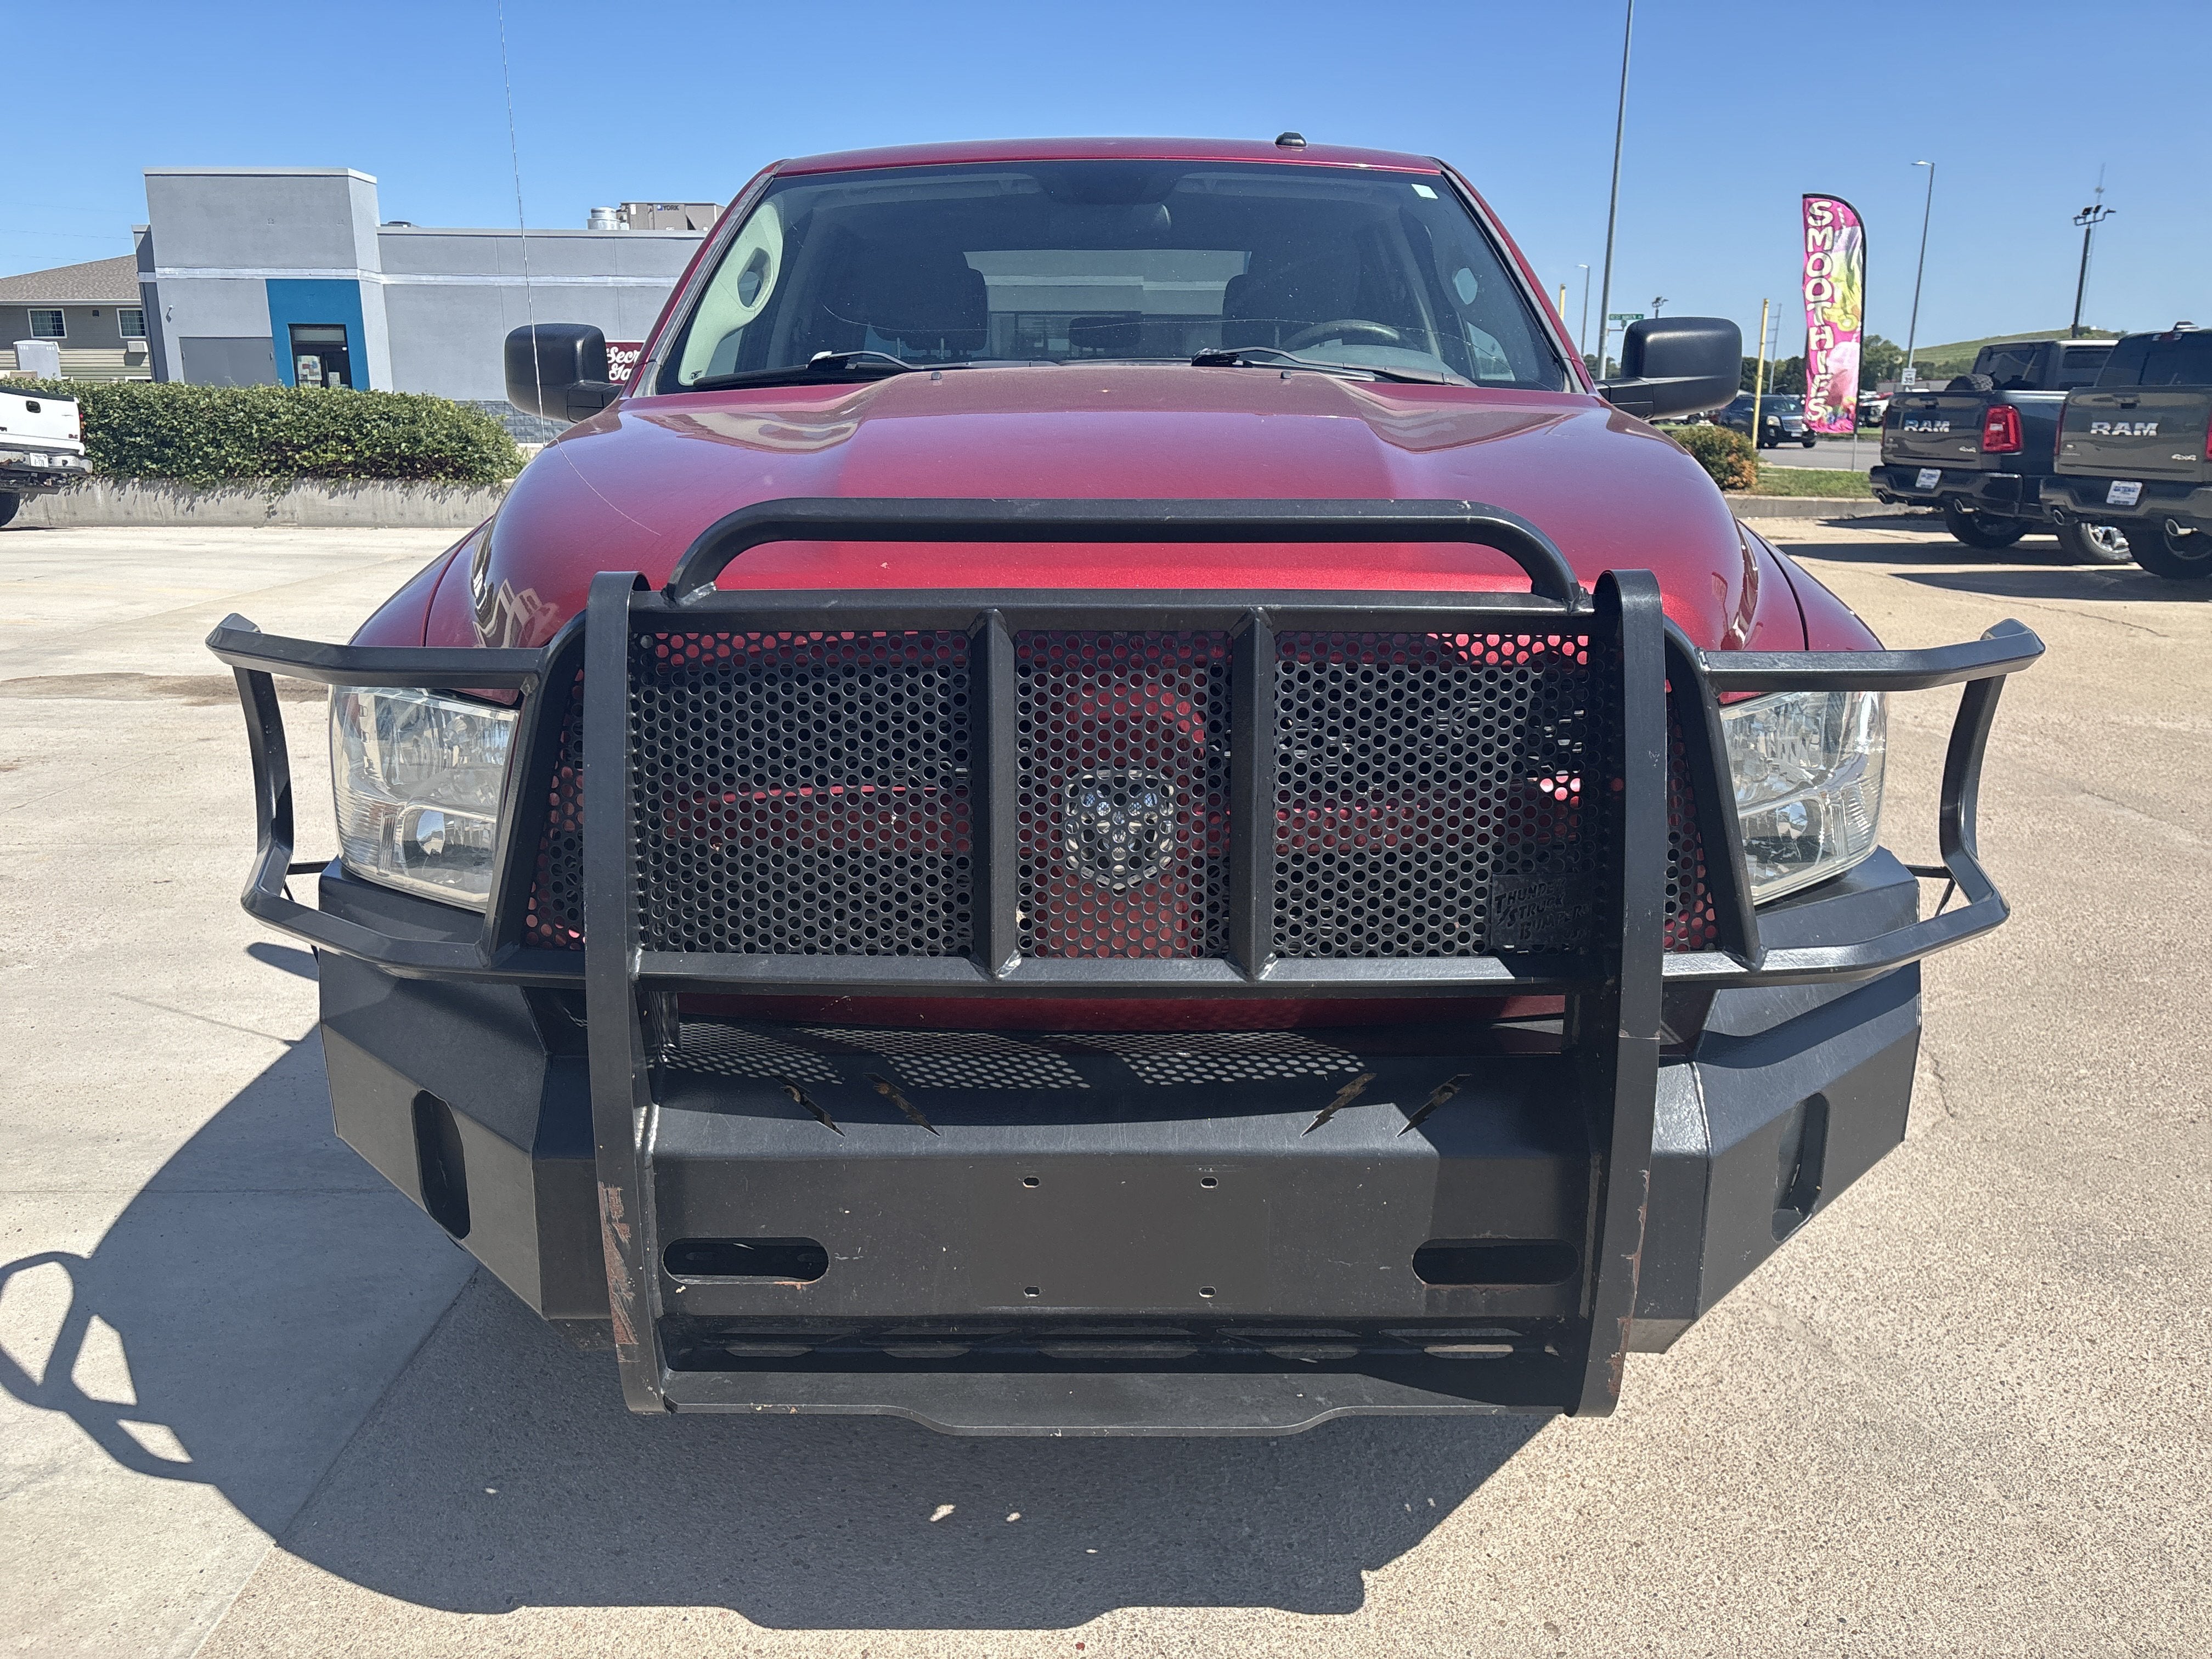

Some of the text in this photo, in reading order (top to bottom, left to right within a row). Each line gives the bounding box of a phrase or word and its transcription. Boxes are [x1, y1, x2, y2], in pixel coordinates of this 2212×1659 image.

[1805, 201, 1835, 421] SMOOTHIES
[1904, 419, 1950, 432] RAM
[2090, 421, 2159, 436] RAM
[1494, 878, 1566, 913] THUNDER
[1507, 893, 1564, 928] STRUCK
